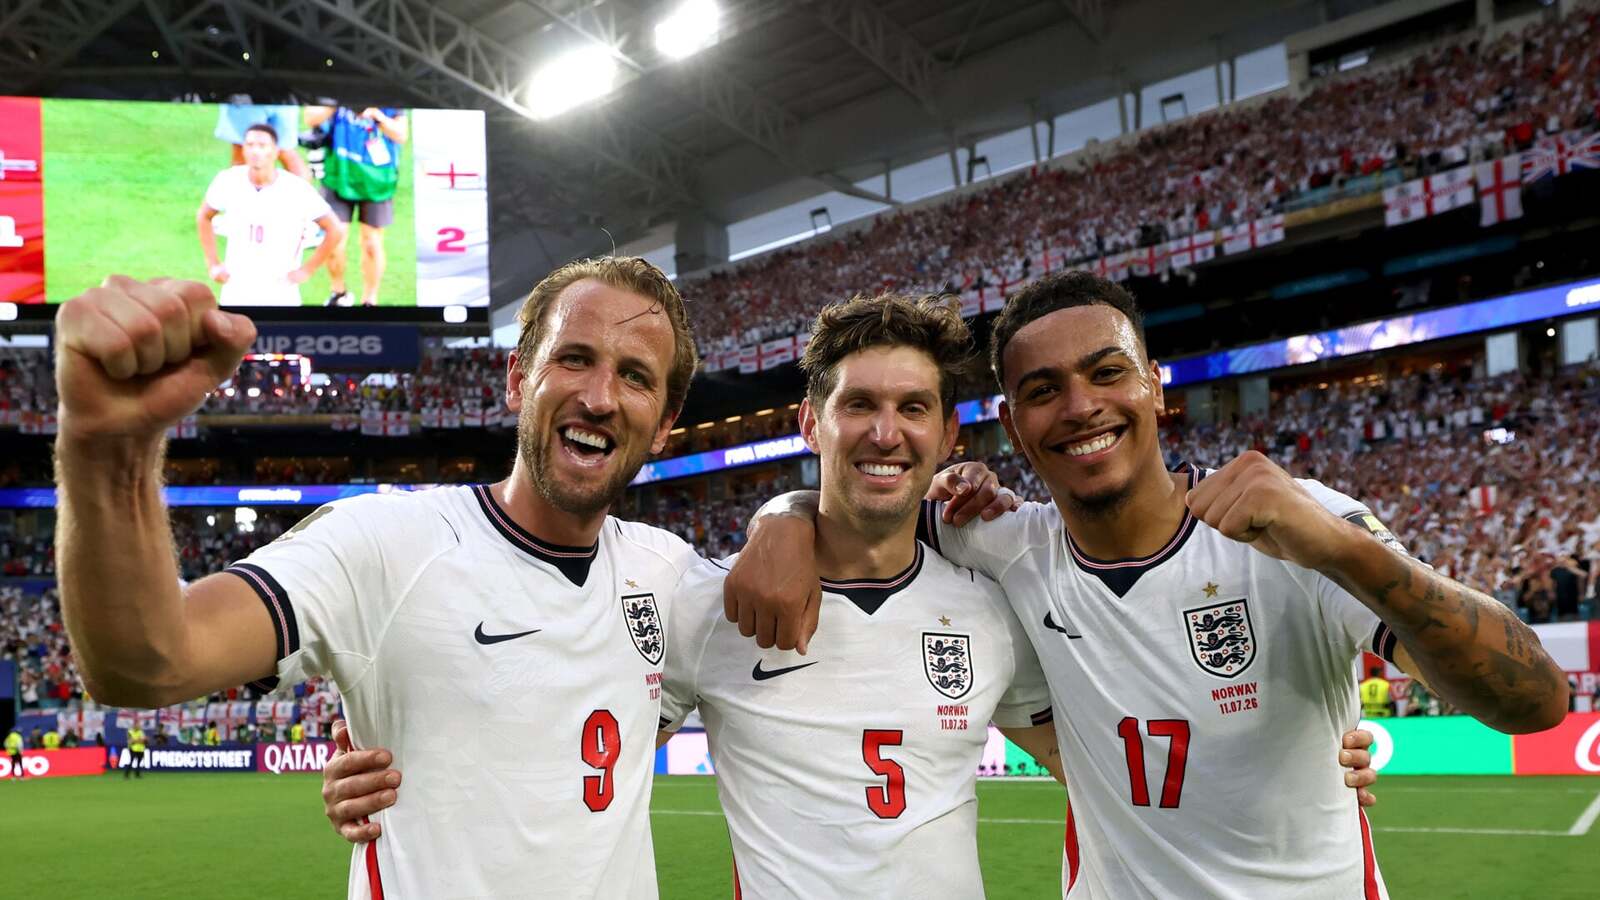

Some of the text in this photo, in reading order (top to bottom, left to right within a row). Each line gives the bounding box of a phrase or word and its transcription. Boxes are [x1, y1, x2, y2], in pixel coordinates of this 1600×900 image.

[436, 226, 467, 253] 2
[252, 335, 382, 355] UP 2026
[754, 436, 805, 459] WORLD
[1211, 682, 1257, 701] NORWAY
[937, 704, 969, 716] NORWAY
[1219, 697, 1258, 715] 11.07.26
[941, 719, 968, 730] 11.07.26
[152, 750, 252, 768] PREDICTSTREET
[264, 744, 329, 774] QATAR
[581, 709, 621, 812] 9
[1117, 716, 1191, 809] 17
[862, 729, 906, 819] 5
